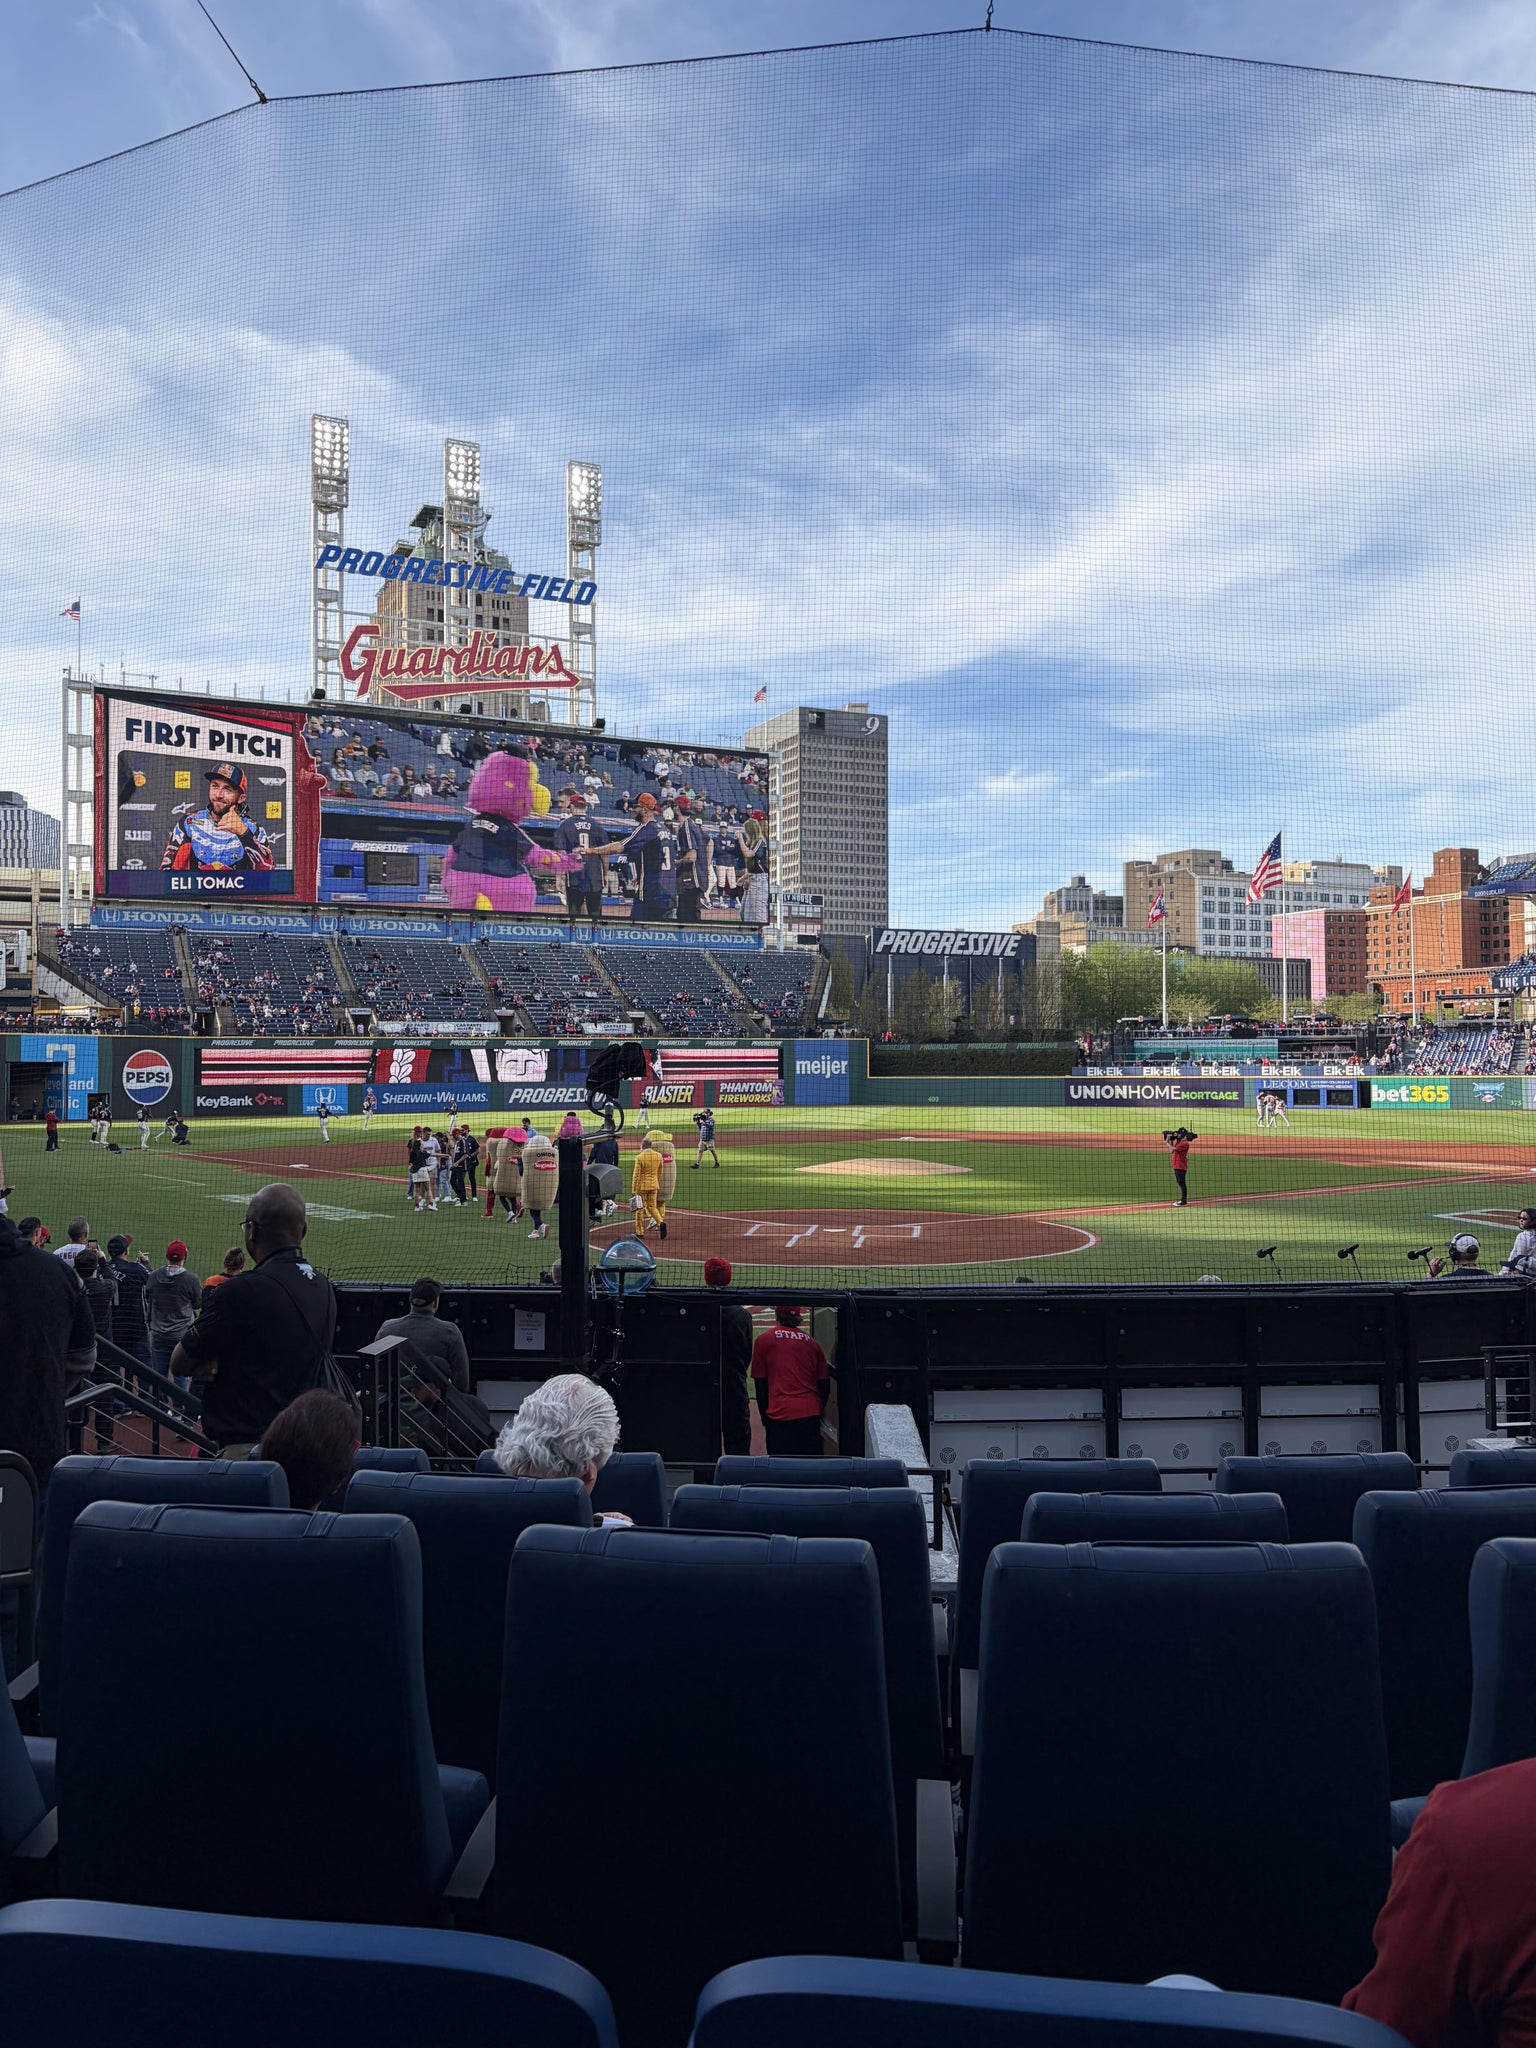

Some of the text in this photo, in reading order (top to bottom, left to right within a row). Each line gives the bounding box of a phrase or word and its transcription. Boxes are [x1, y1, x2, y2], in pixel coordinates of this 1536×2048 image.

[314, 545, 597, 606] PROGRESSIVE FIELD
[340, 624, 572, 699] Guardians
[861, 716, 880, 735] 9
[125, 717, 282, 759] FIRST PITCH
[171, 876, 245, 890] ELI TOMAC
[122, 911, 205, 924] HONDA
[231, 915, 309, 928] HONDA
[368, 920, 440, 933] HONDA
[497, 925, 565, 937] HONDA
[616, 931, 679, 942] HONDA
[698, 933, 756, 944] HONDA
[876, 930, 1022, 957] PROGRESSIVE
[1499, 977, 1518, 988] THE
[795, 1056, 848, 1079] meijer
[126, 1071, 170, 1084] PEPSI
[719, 1082, 773, 1093] PHANTOM
[1371, 1084, 1449, 1103] bet365
[644, 1085, 694, 1104] BLASTER
[718, 1093, 772, 1104] FIREWORKS
[1181, 1091, 1239, 1101] MORTGAGE
[197, 1095, 253, 1109] KeyBank
[774, 1330, 810, 1341] STAFF
